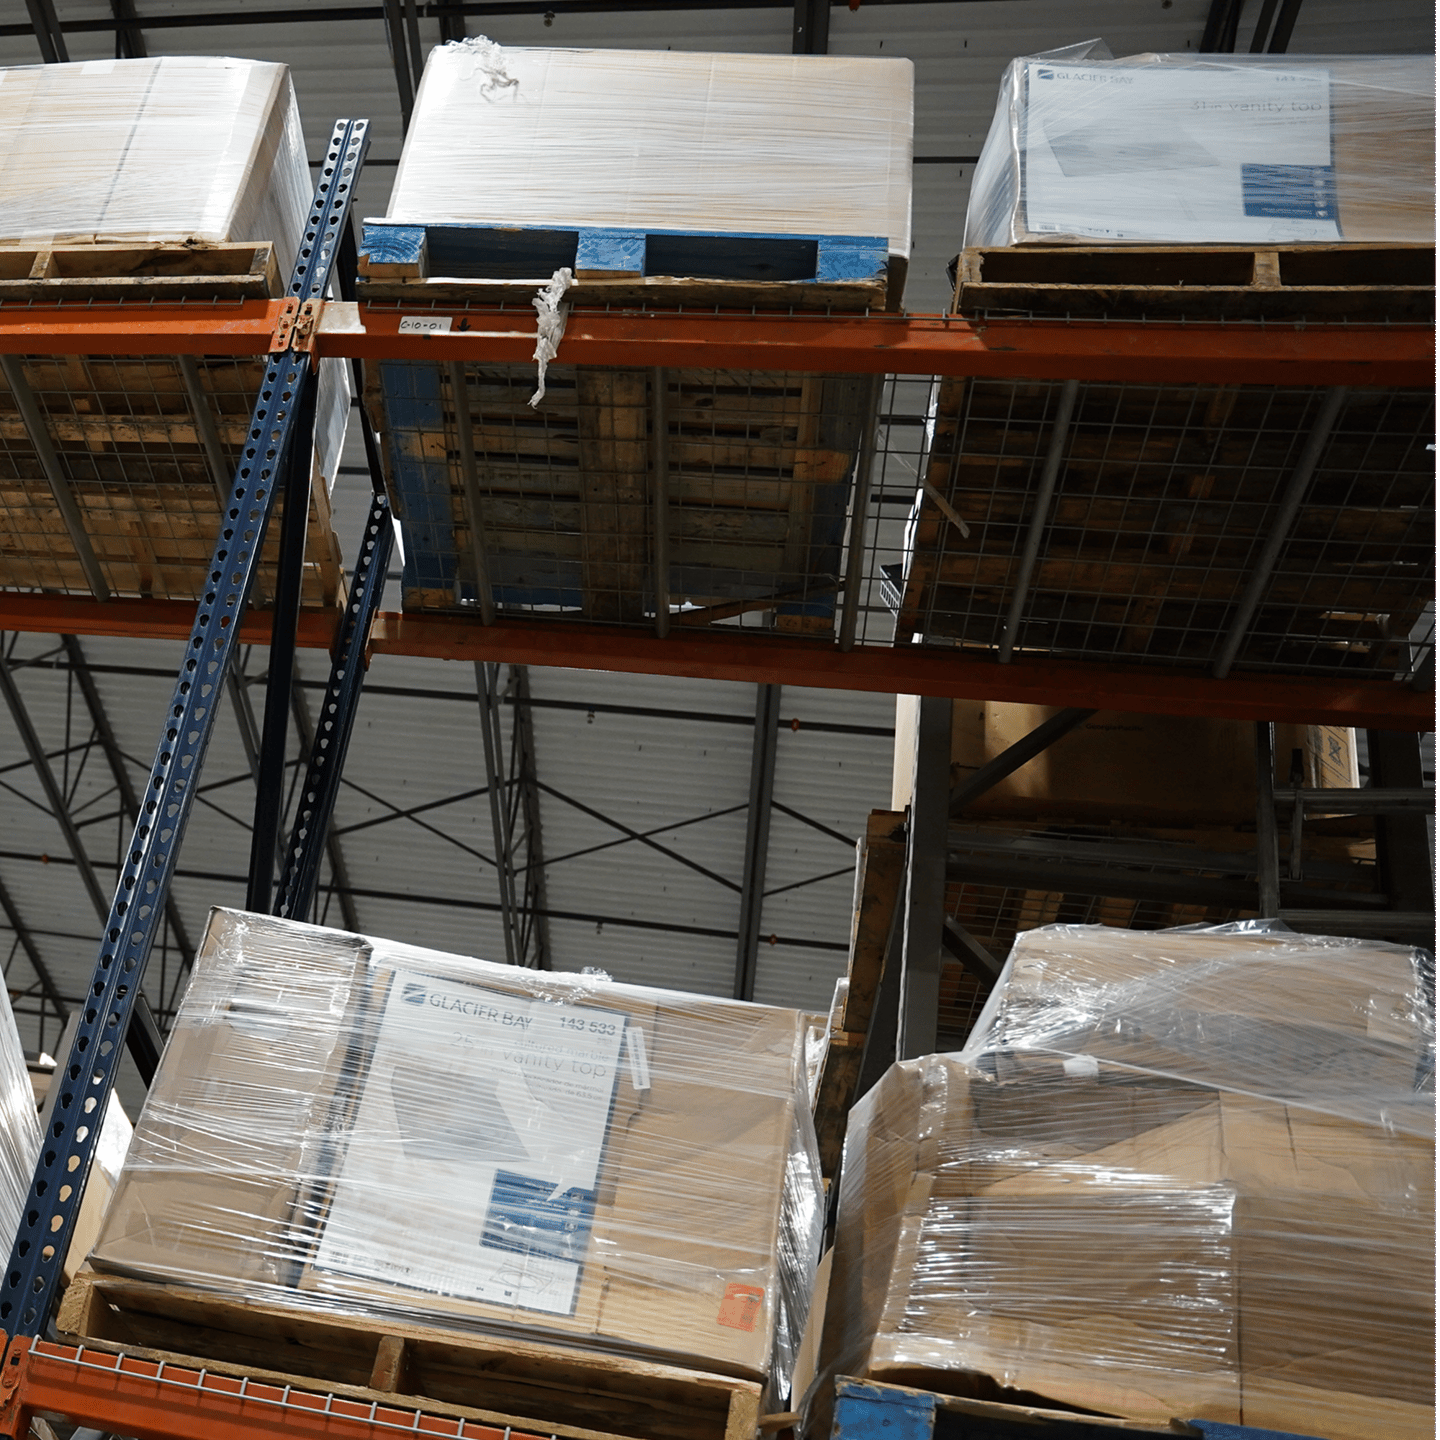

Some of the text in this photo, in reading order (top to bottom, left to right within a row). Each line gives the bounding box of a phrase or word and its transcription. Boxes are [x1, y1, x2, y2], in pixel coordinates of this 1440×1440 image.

[1229, 101, 1285, 113] vanity
[429, 993, 533, 1030] GLACIER BAY
[560, 1016, 616, 1036] 143 533
[450, 1031, 475, 1049] 25
[503, 1051, 565, 1073] vanity
[572, 1060, 607, 1079] top
